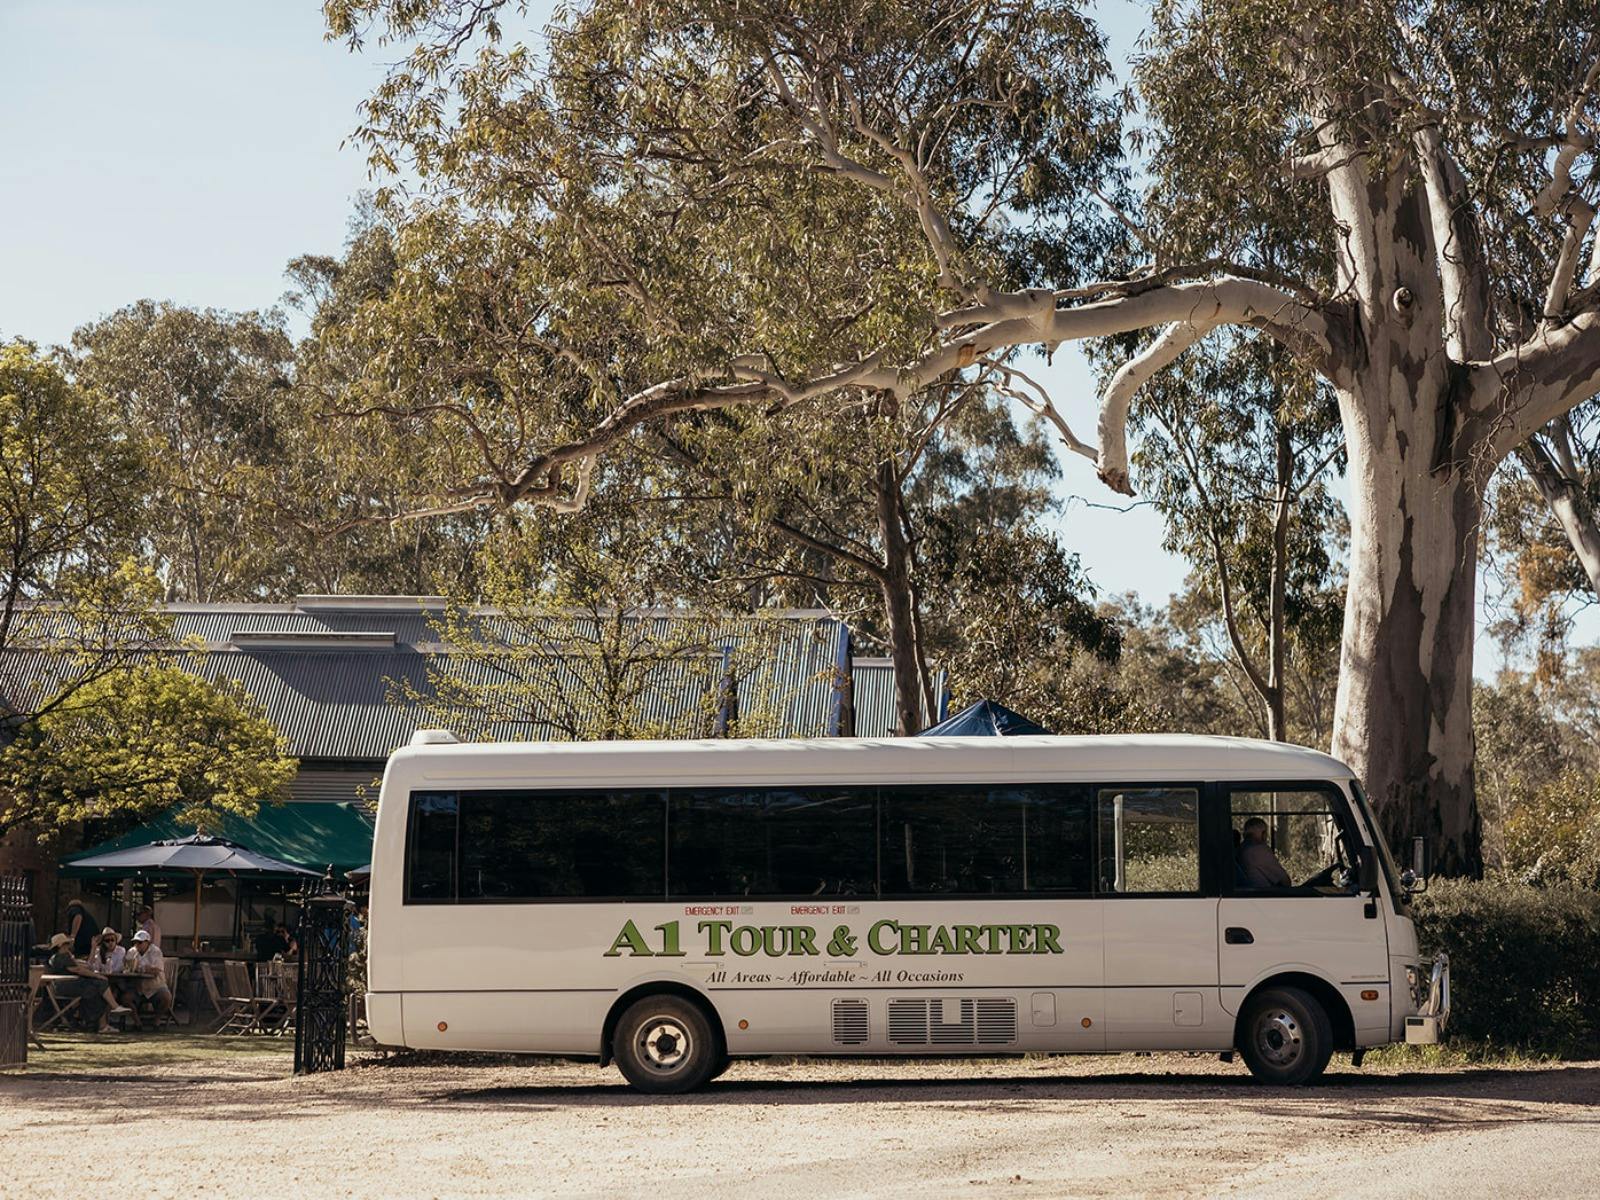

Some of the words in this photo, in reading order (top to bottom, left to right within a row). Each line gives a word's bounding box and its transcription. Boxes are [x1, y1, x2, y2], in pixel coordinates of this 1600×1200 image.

[685, 906, 723, 916] EMERGENCY
[726, 906, 740, 916] EXIT
[791, 905, 829, 915] EMERGENCY
[832, 905, 845, 915] EXIT
[602, 918, 687, 958] A1
[697, 920, 821, 958] TOUR
[826, 925, 859, 957] &
[867, 919, 1064, 956] CHARTER
[705, 971, 726, 983] All
[731, 971, 771, 983] Areas
[788, 970, 856, 986] Affordable
[871, 970, 891, 982] All
[896, 970, 964, 982] Occasions
